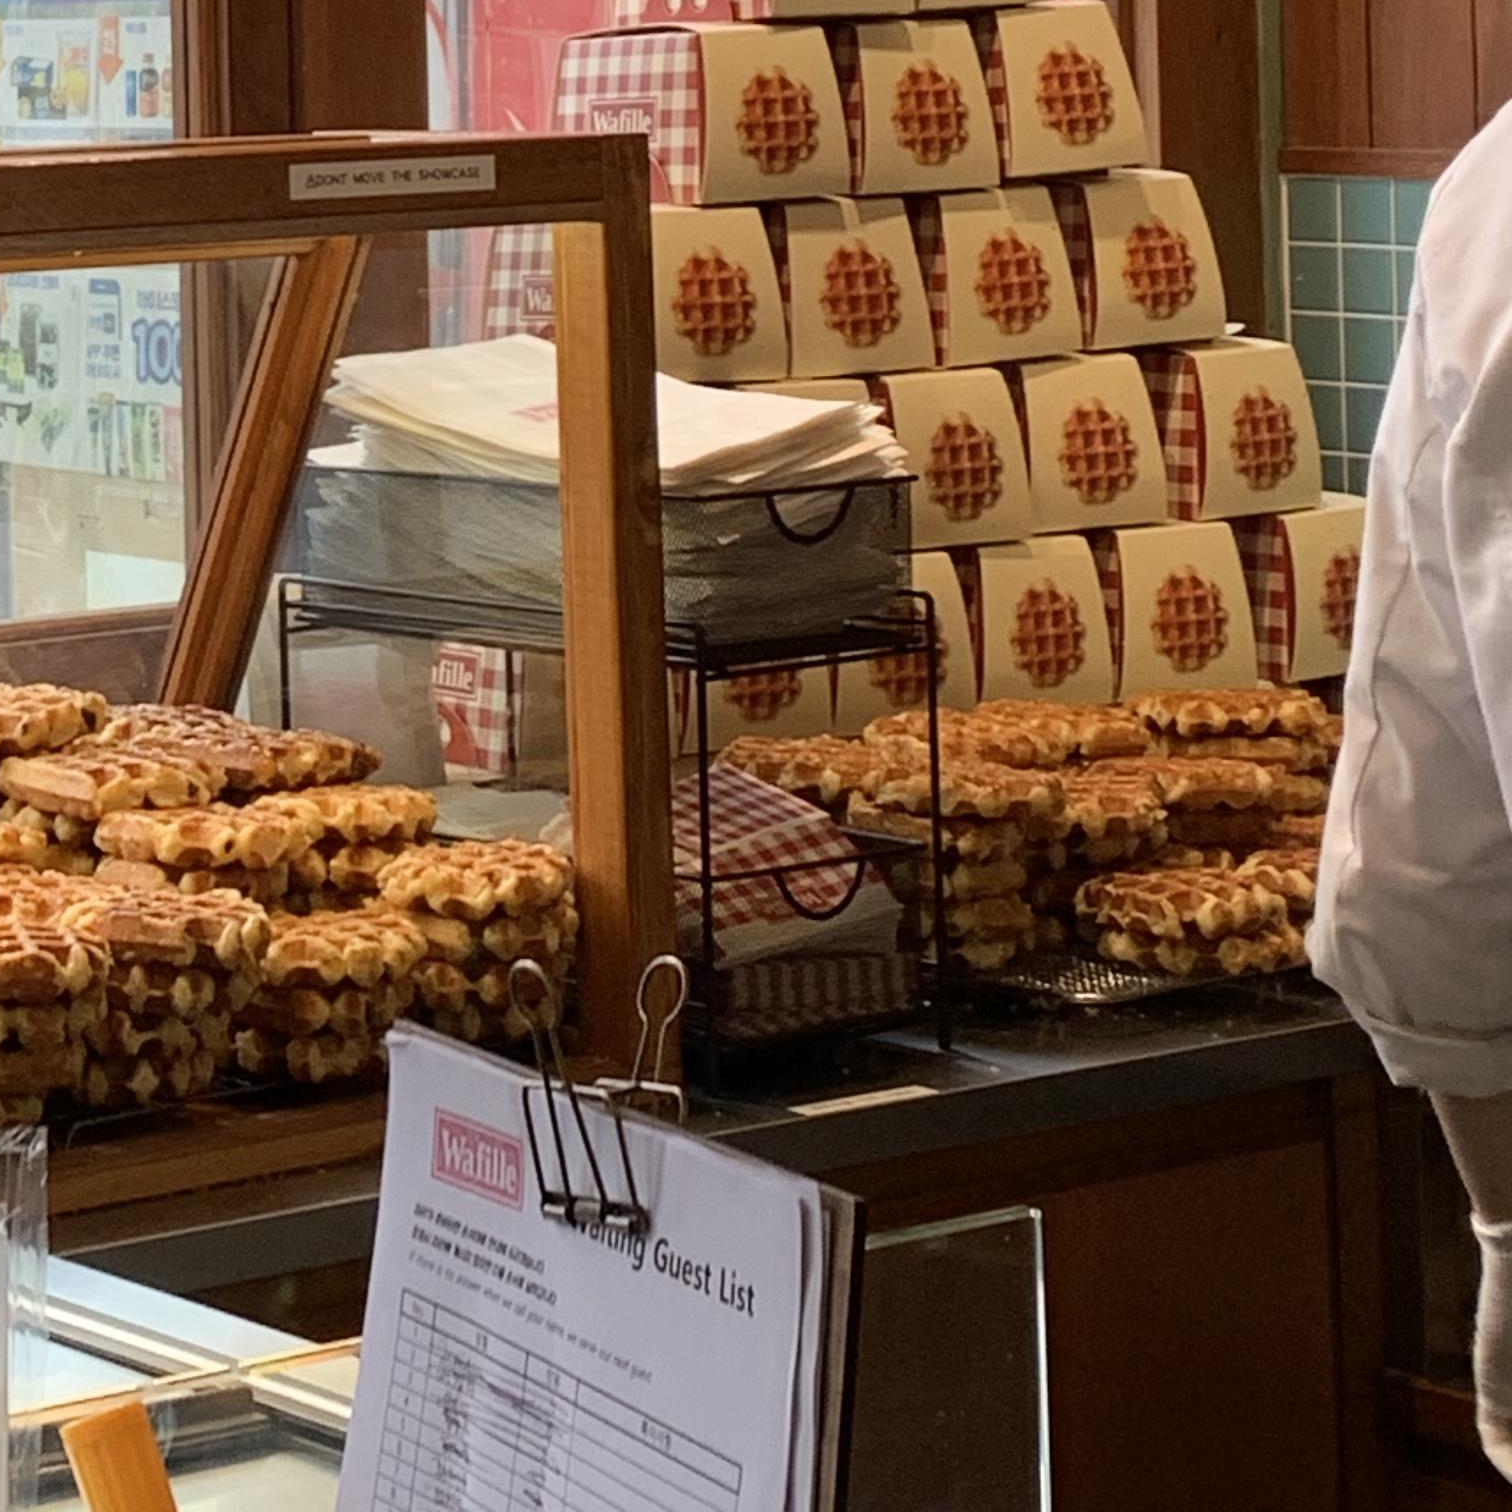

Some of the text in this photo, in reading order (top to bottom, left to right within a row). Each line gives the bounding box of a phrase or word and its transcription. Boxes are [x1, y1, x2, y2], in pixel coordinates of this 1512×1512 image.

[591, 109, 653, 135] Wafille
[353, 170, 386, 185] MOVE
[392, 169, 413, 182] THE
[419, 166, 481, 181] SHOWCASE
[431, 658, 474, 690] fille
[440, 1125, 519, 1193] Wafille
[652, 1236, 712, 1297] Guest
[719, 1269, 756, 1318] List
